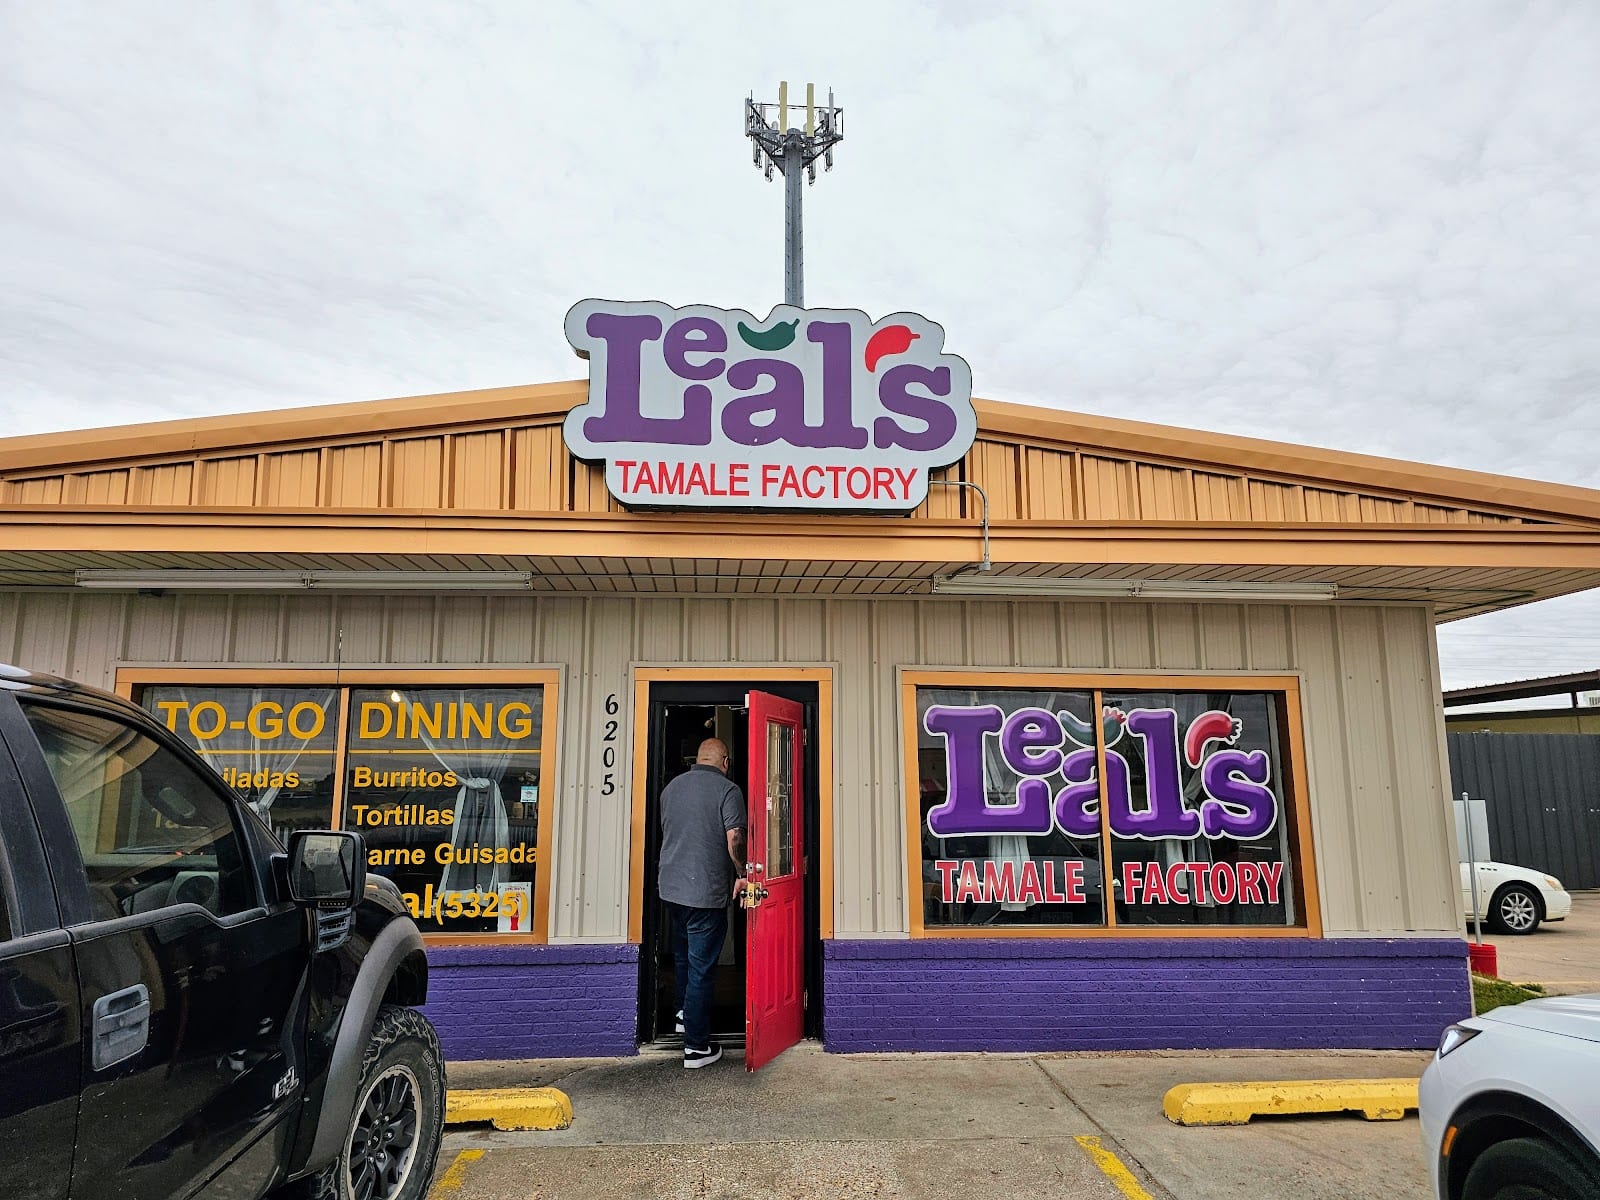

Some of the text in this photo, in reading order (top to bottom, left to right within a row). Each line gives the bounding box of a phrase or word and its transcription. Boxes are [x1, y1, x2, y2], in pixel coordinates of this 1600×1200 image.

[615, 459, 918, 500] TAMALE FACTORY
[157, 700, 533, 741] TO-GO DINING
[601, 693, 619, 796] 6205
[353, 766, 458, 788] Burritos
[352, 804, 455, 826] Tortillas
[367, 842, 537, 866] arne Guisada
[935, 860, 1284, 905] TAMALE FACTORY
